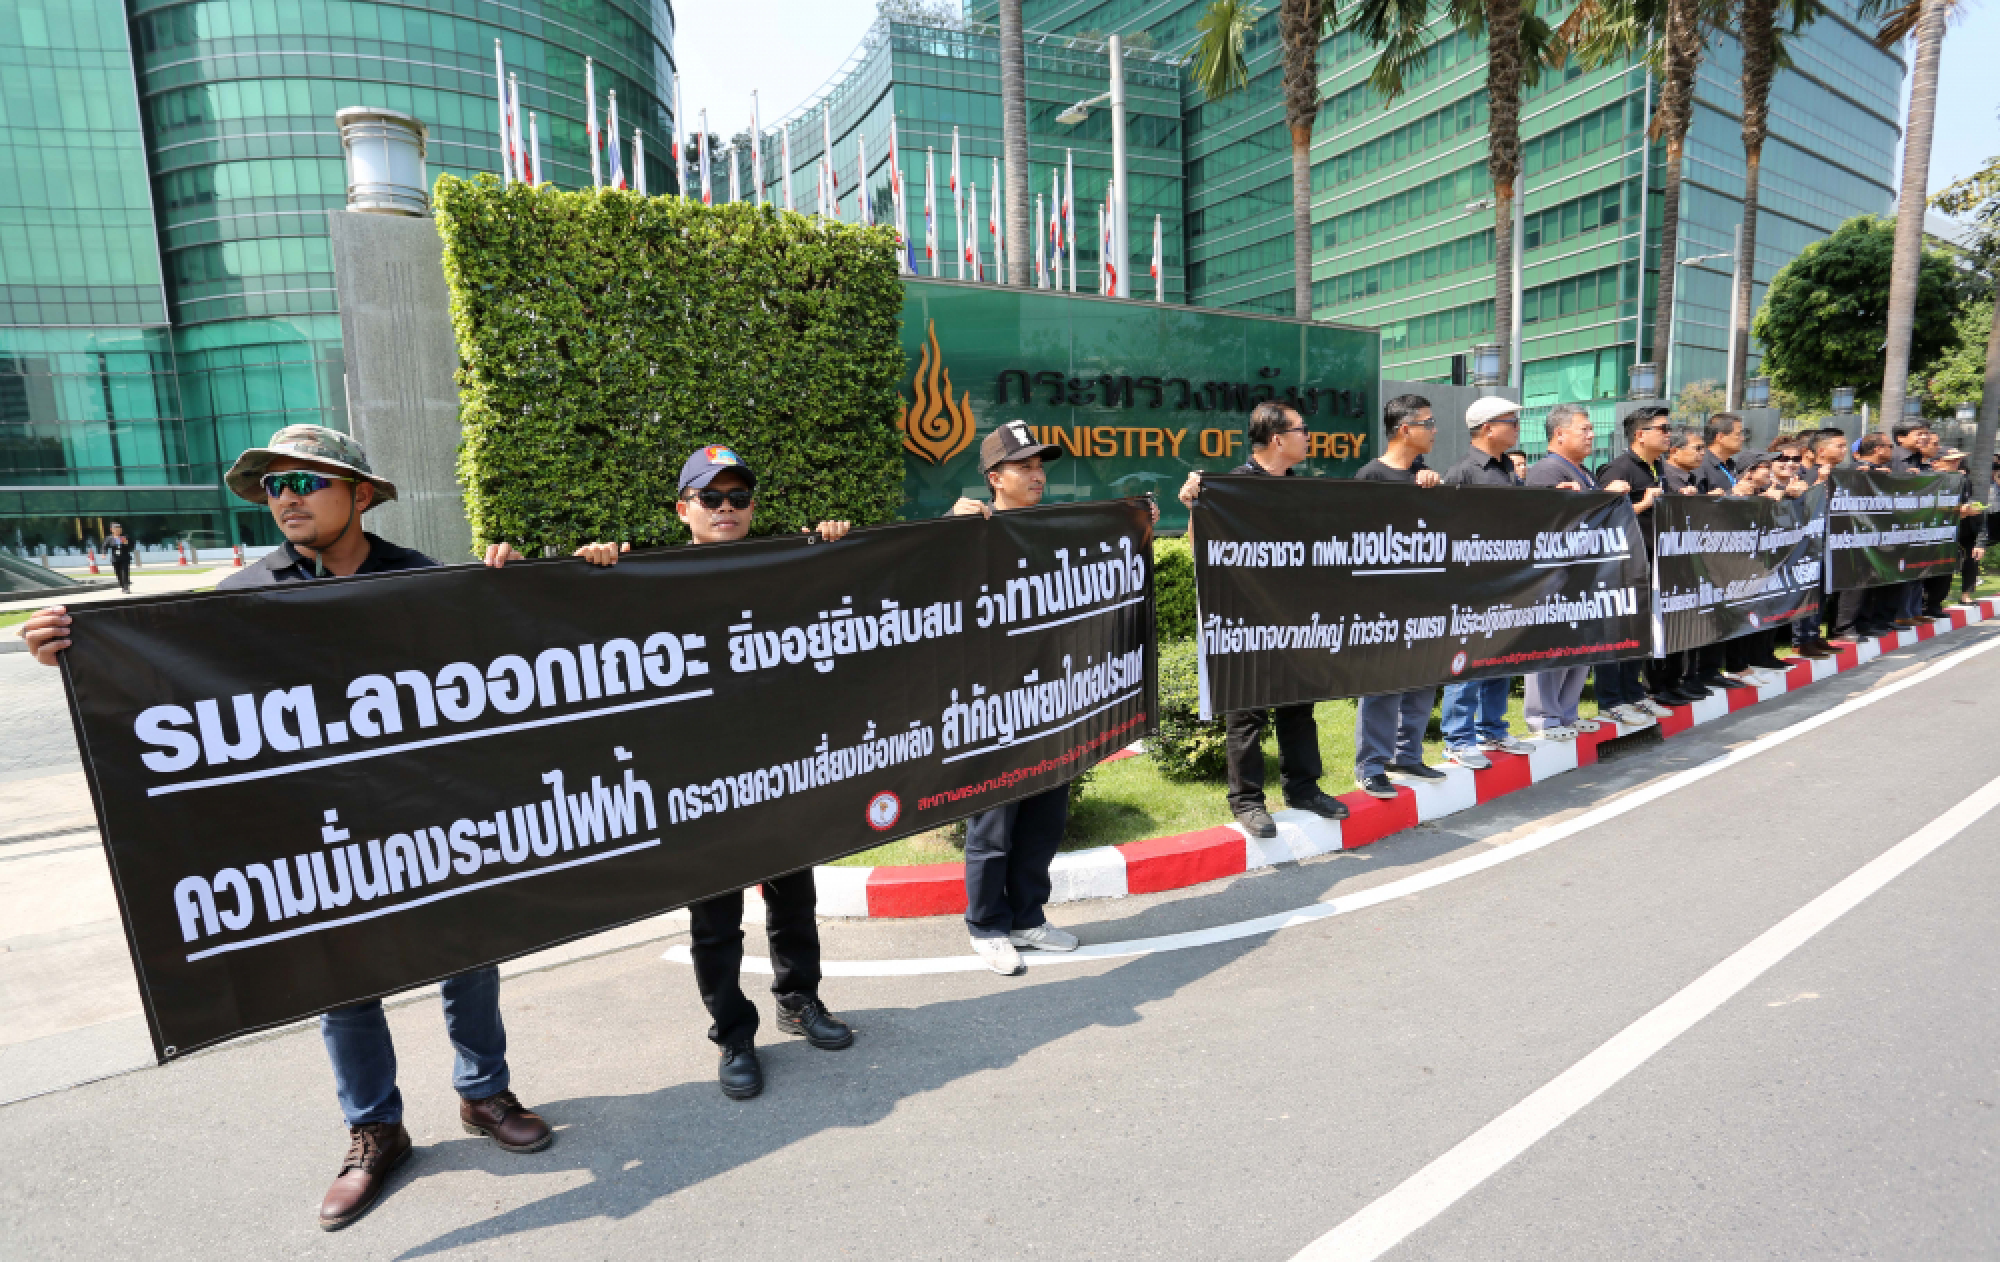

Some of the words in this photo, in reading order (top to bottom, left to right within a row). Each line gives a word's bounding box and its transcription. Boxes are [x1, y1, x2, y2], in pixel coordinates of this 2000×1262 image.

[1029, 425, 1188, 458] INISTRY
[1201, 428, 1243, 458] OF
[134, 630, 710, 774] รมต.ลาออกเถอะ
[728, 596, 963, 673] ยิ่งอยู่ยิ่งสับสน
[976, 536, 1146, 628] ว่าท่านไม่เข้าใจ
[173, 746, 657, 943] ความมั่นคงระบบไฟฟ้า
[668, 720, 933, 825] กระจายความเสี่ยงเชื้อเพลิง
[941, 644, 1144, 750] สำคัญเพียงใดต่อประเทศ
